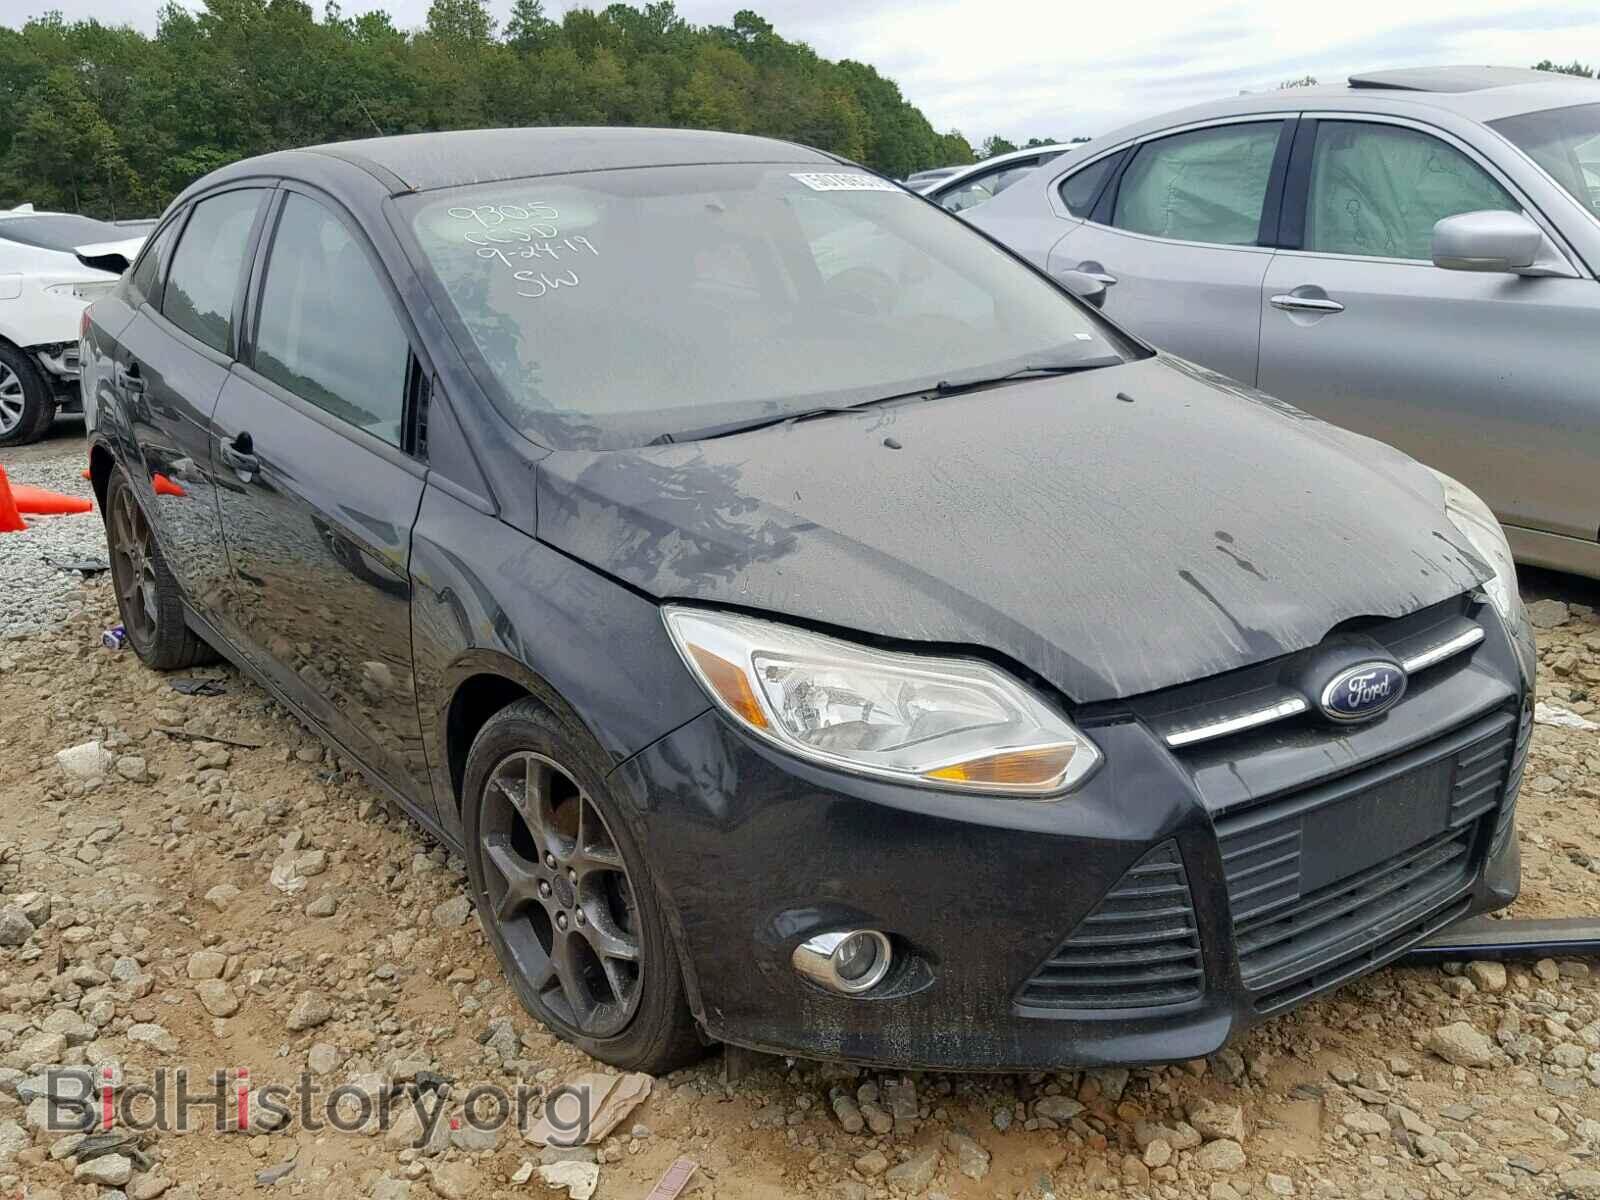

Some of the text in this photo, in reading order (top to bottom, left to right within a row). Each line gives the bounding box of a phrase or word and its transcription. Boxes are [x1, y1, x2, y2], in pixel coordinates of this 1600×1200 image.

[448, 202, 559, 228] 9305
[476, 235, 600, 268] 9-24-19
[513, 269, 579, 297] SW
[1347, 672, 1391, 708] Ford
